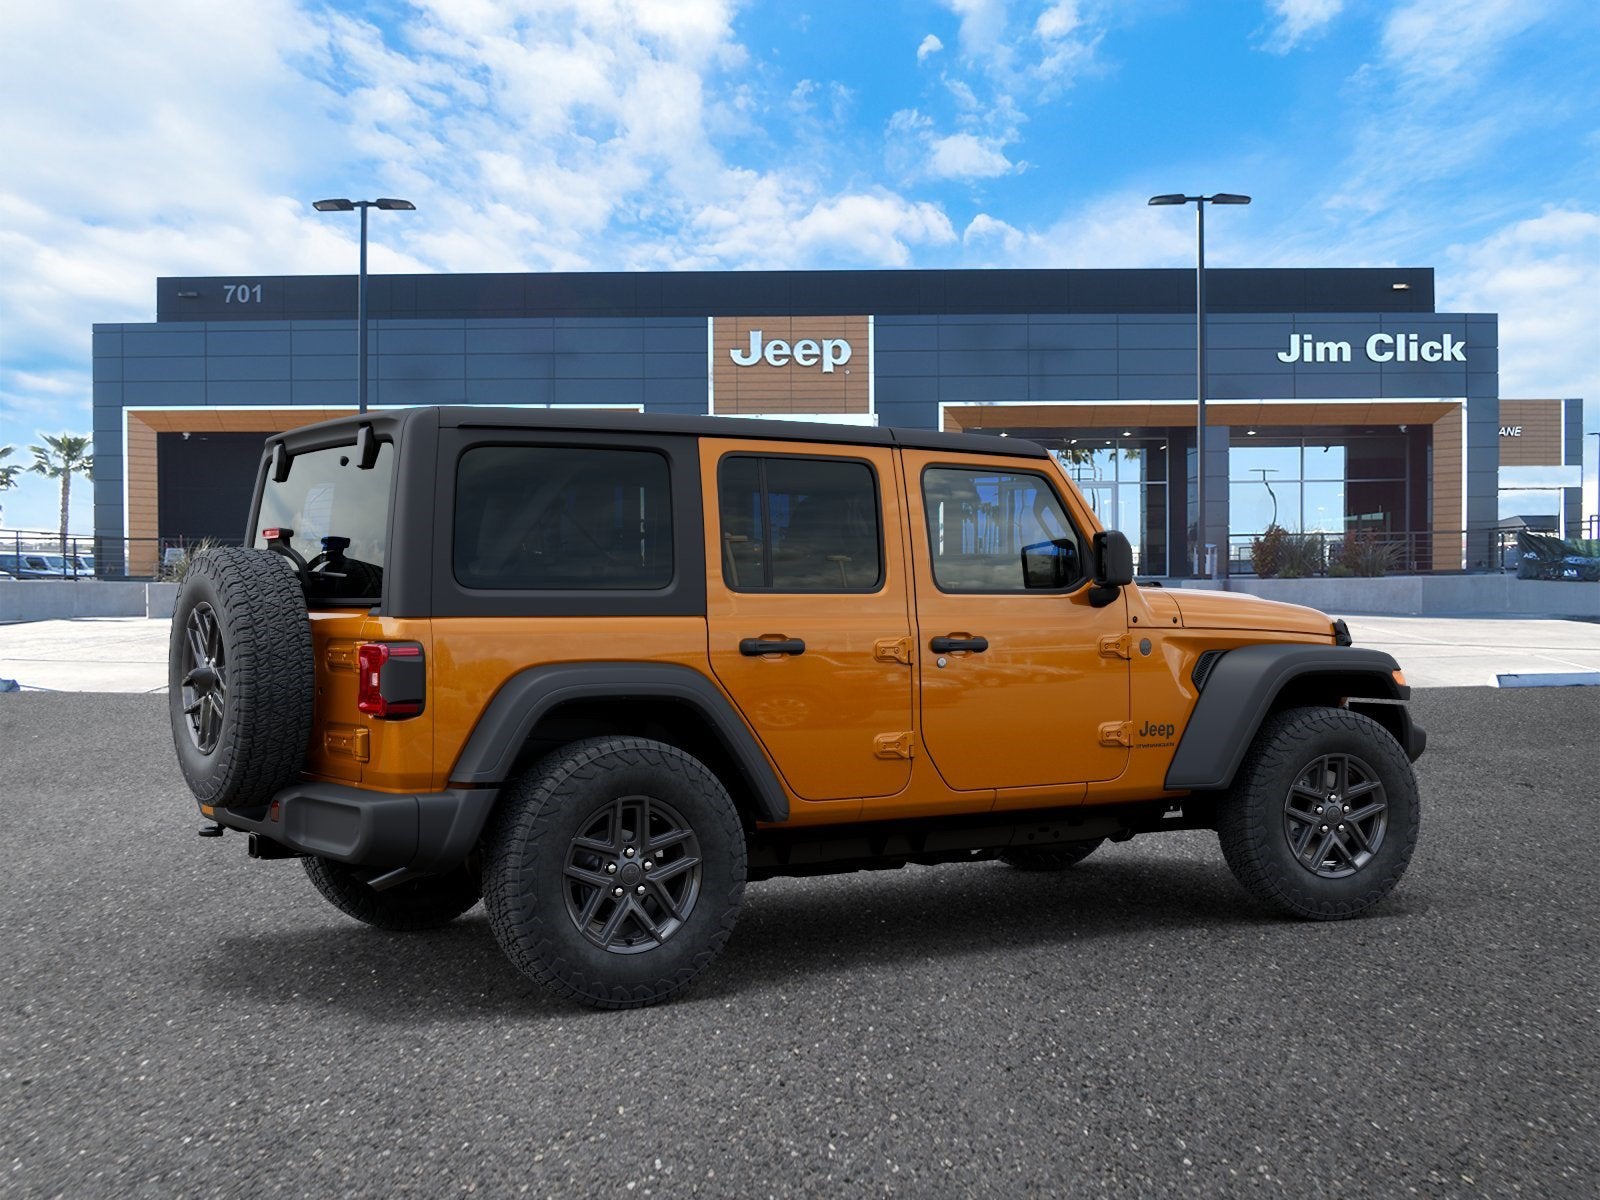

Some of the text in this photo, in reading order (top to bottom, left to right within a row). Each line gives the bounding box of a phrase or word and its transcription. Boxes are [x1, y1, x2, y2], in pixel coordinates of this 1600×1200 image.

[223, 284, 262, 303] 701
[729, 329, 852, 373] Jeep
[1277, 333, 1467, 363] Jim Click
[1498, 426, 1522, 437] ANE
[1139, 720, 1175, 739] Jeep
